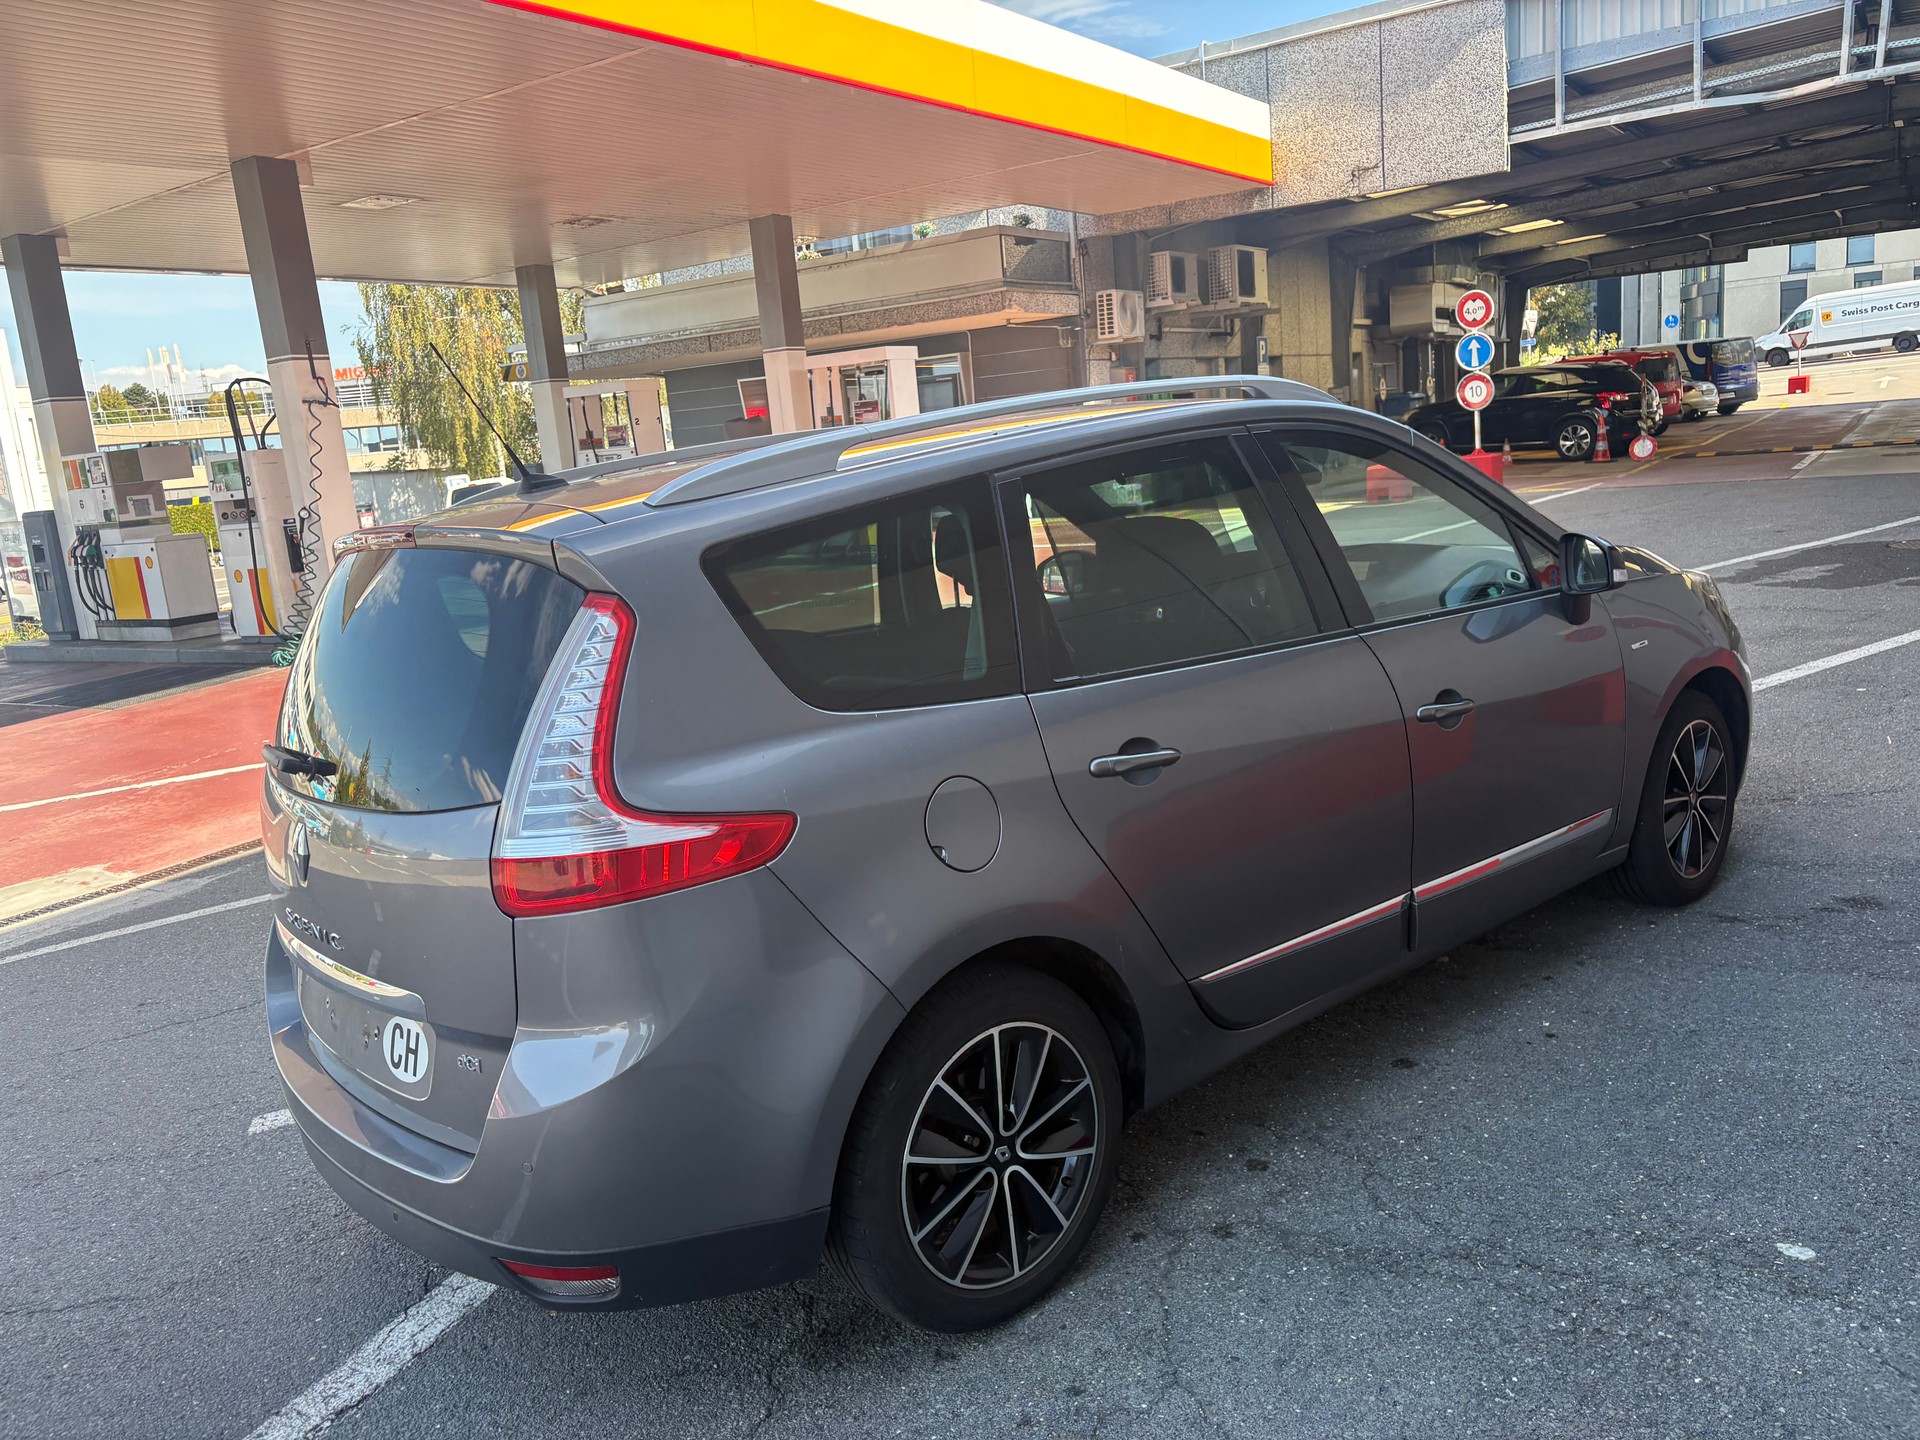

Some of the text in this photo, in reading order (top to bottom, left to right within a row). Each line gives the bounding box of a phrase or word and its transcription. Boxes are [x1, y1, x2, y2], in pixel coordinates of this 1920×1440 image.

[1841, 301, 1920, 317] Swiss Post Carg
[1259, 341, 1266, 362] P
[1469, 385, 1483, 398] 10
[209, 480, 215, 490] 7
[246, 476, 252, 487] 8
[79, 500, 85, 509] 6
[286, 907, 344, 950] SCENIC
[390, 1022, 420, 1078] CH
